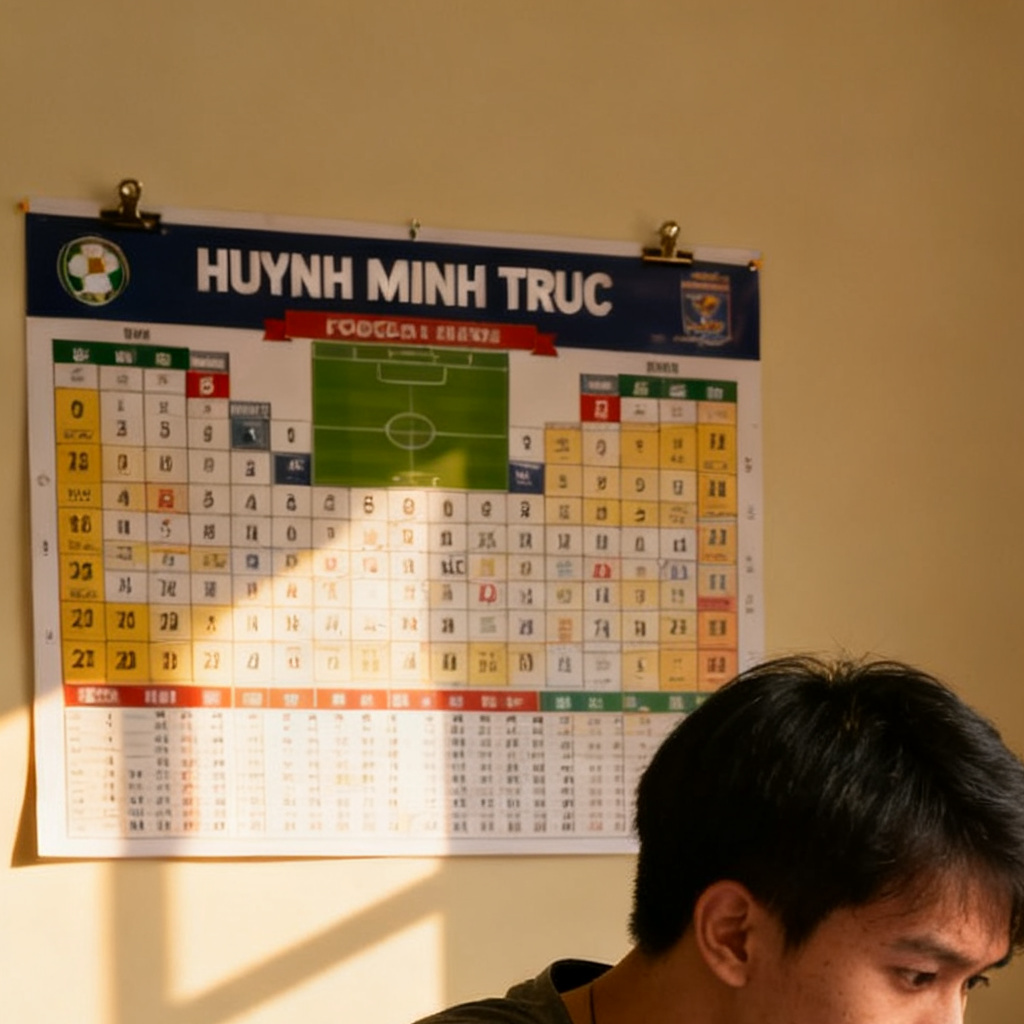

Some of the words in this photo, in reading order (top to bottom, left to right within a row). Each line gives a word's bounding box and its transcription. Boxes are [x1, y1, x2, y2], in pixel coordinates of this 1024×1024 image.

[197, 247, 354, 300] HUYNH
[367, 257, 487, 308] MINH
[497, 265, 614, 317] TRUC
